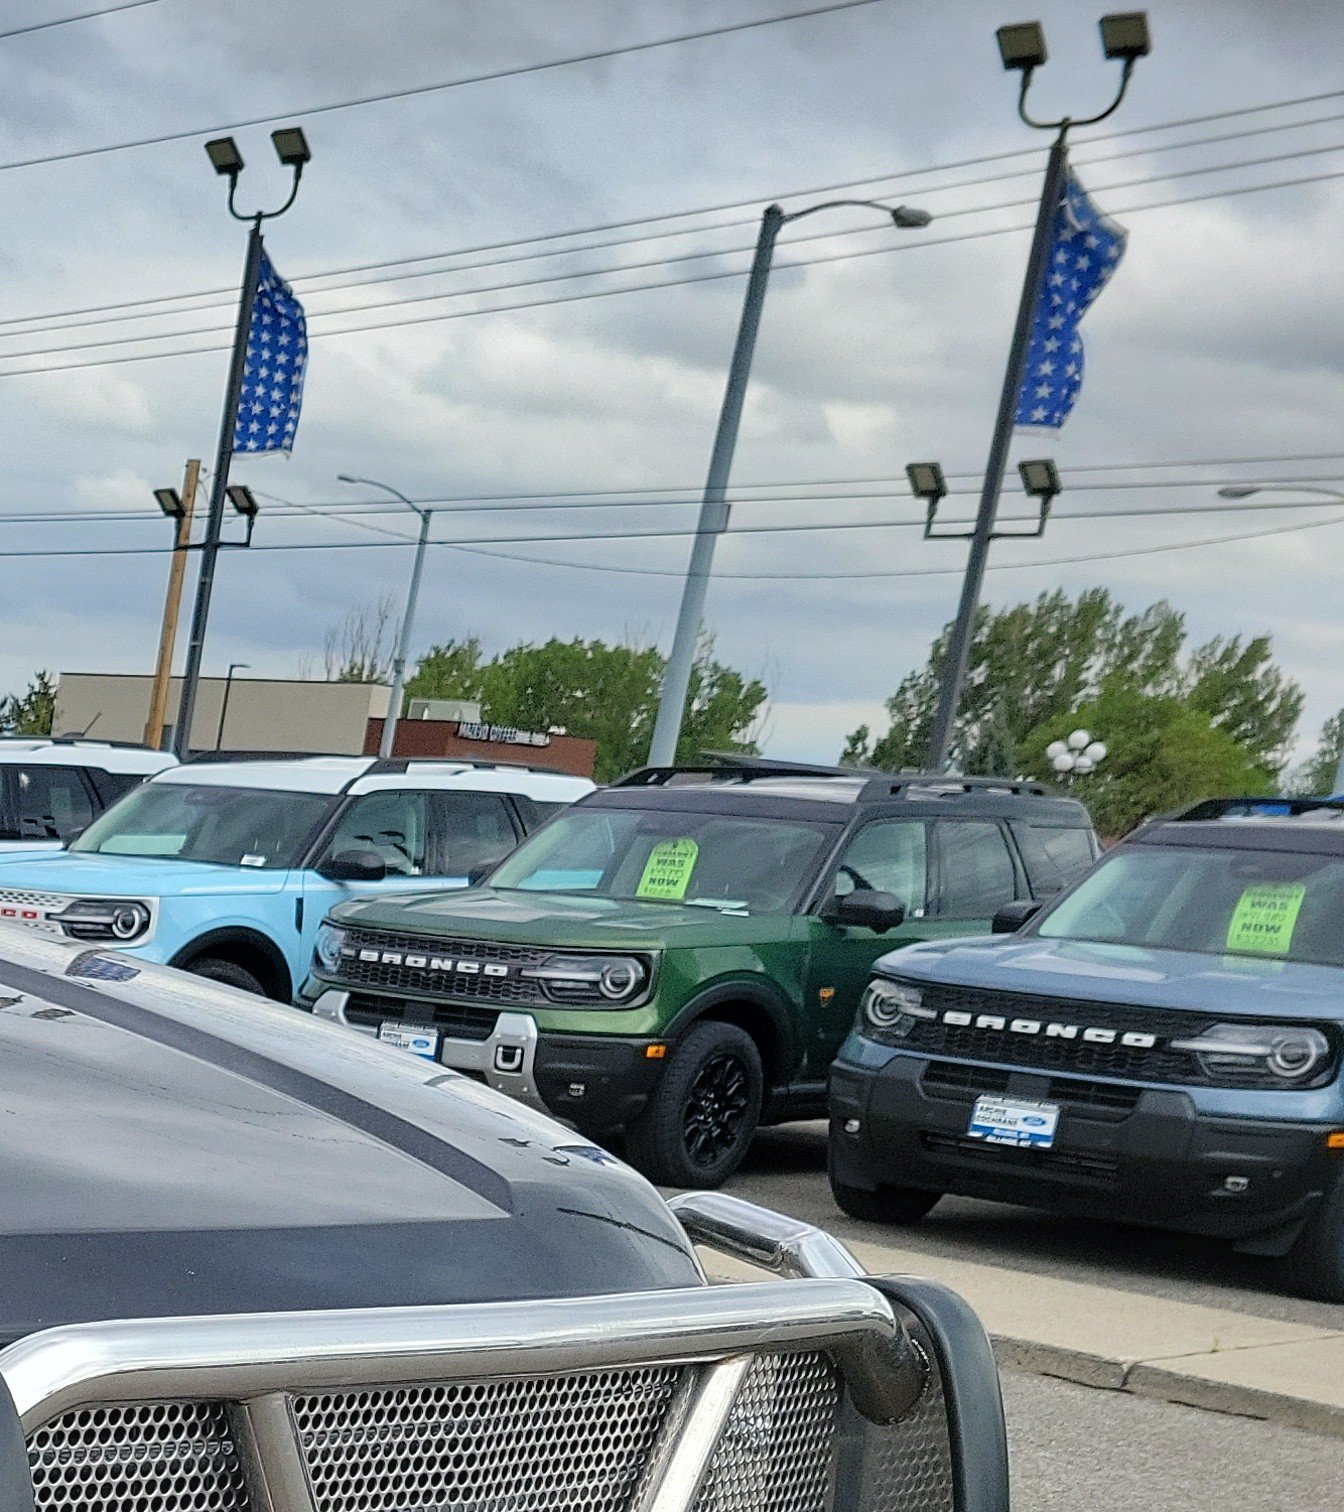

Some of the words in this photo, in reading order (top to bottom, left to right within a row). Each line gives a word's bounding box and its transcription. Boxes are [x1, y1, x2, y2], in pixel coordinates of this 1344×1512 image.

[649, 877, 679, 886] NOW
[1251, 901, 1289, 911] WAS
[1240, 922, 1282, 934] NOW
[359, 949, 509, 977] BRONCO
[942, 1011, 1157, 1049] BRONCO
